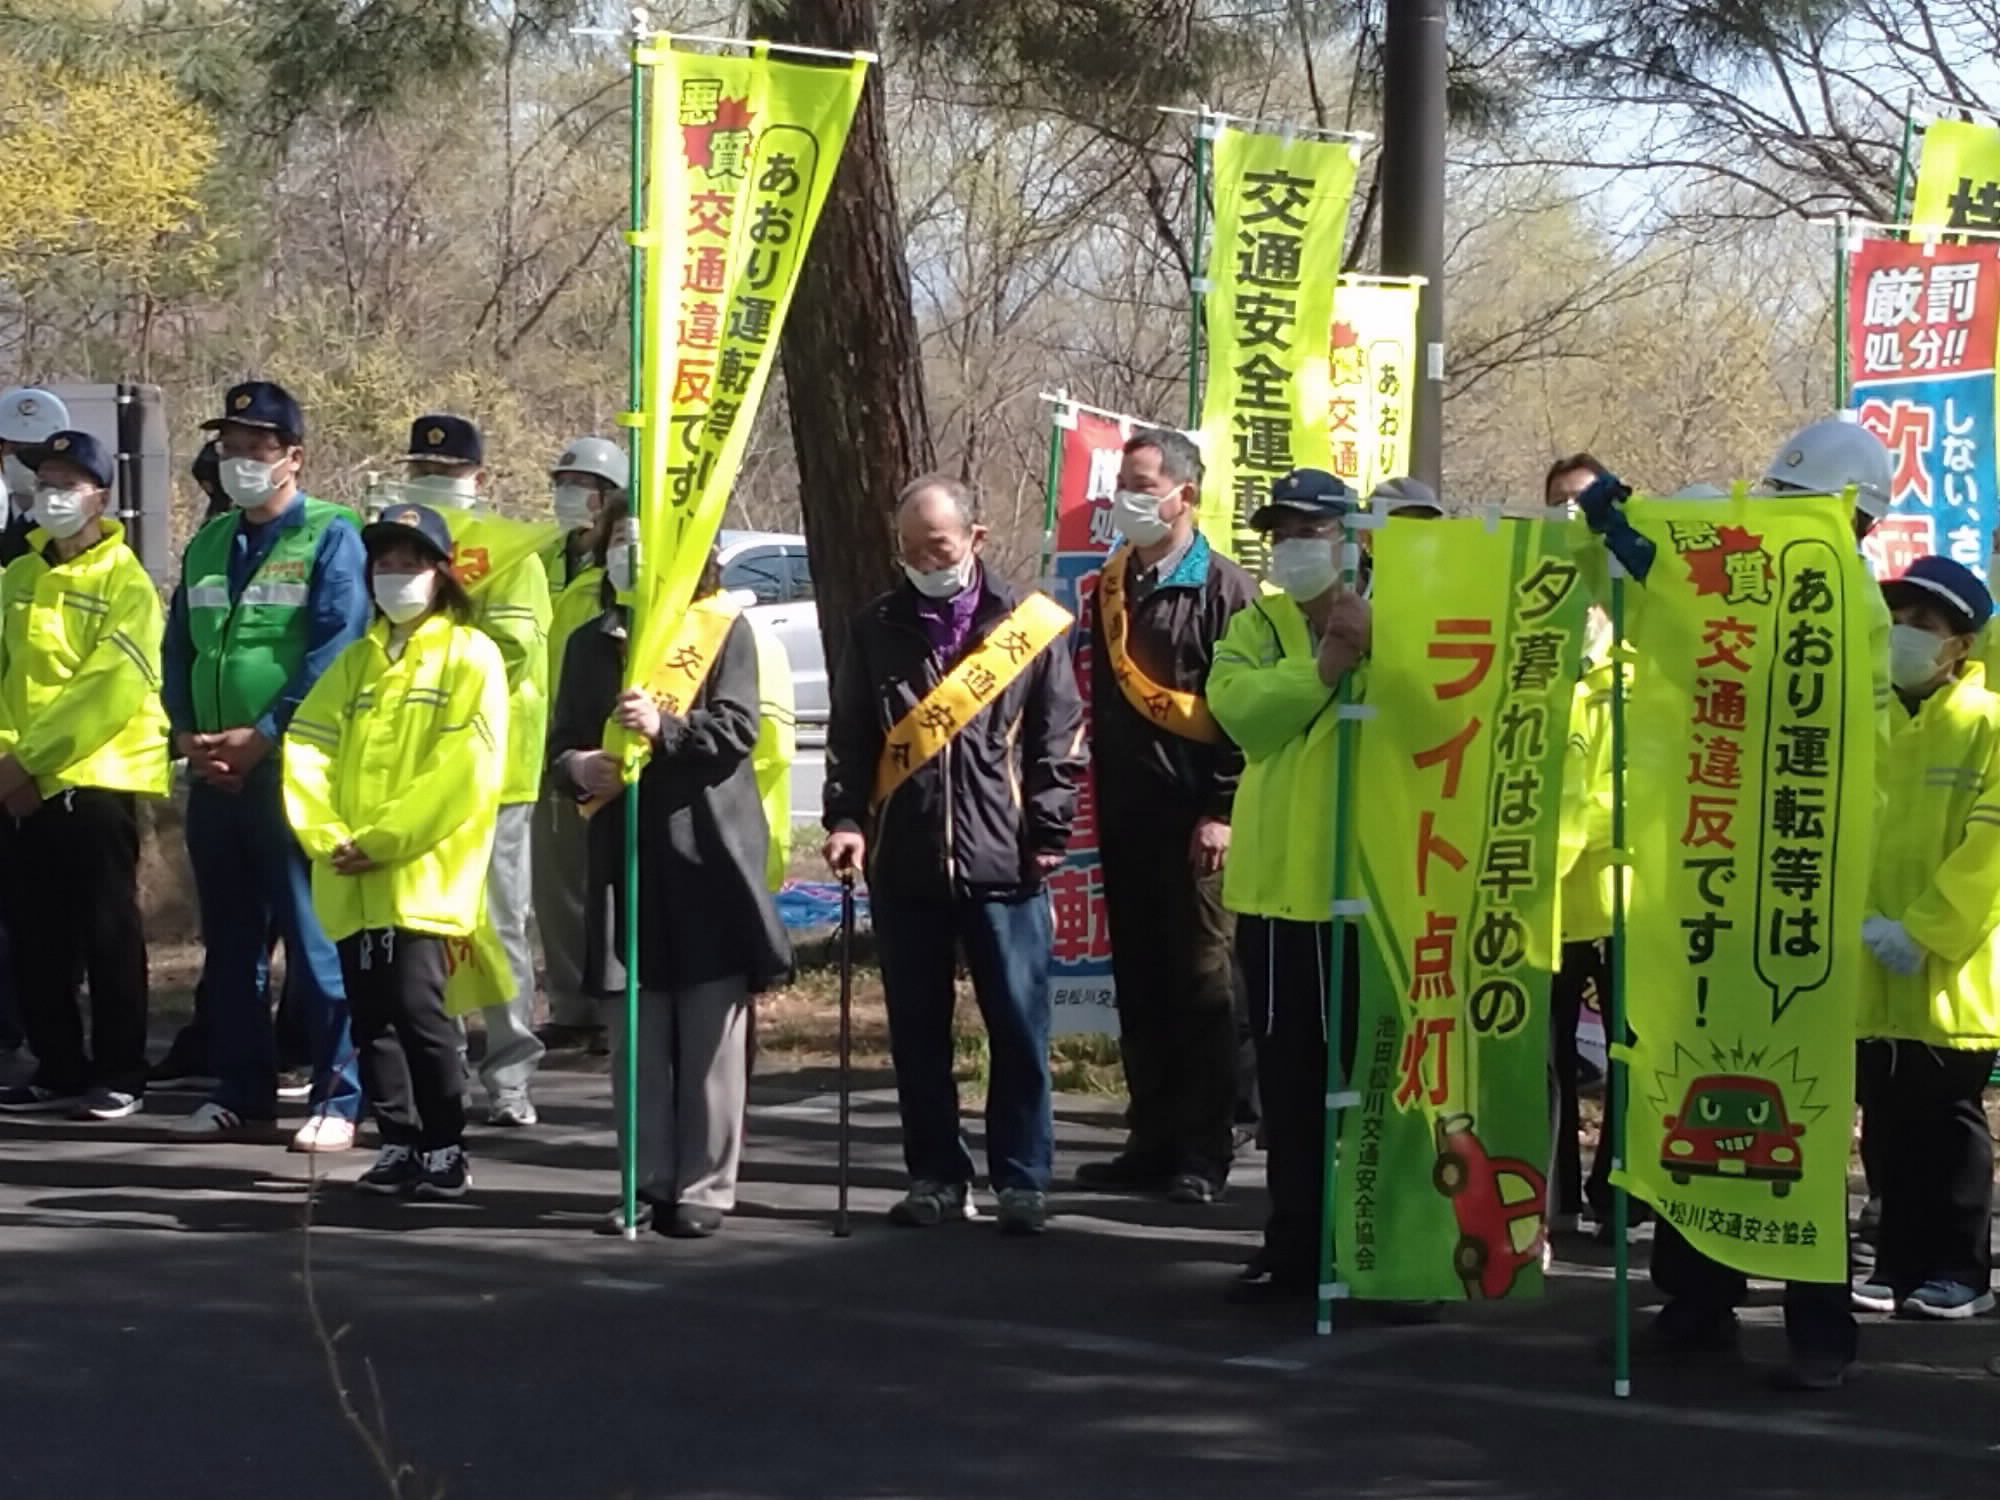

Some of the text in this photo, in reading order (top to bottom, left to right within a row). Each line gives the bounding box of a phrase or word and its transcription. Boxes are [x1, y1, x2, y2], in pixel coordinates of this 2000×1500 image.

[679, 79, 751, 179] 悪質
[1863, 262, 1980, 327] 厳罰
[1378, 364, 1400, 475] あおり
[1666, 520, 1773, 606] 悪質
[1469, 559, 1579, 1035] 夕暮れは早めの
[1770, 567, 1835, 958] あおり運転等は
[1397, 618, 1497, 1106] ライト点灯
